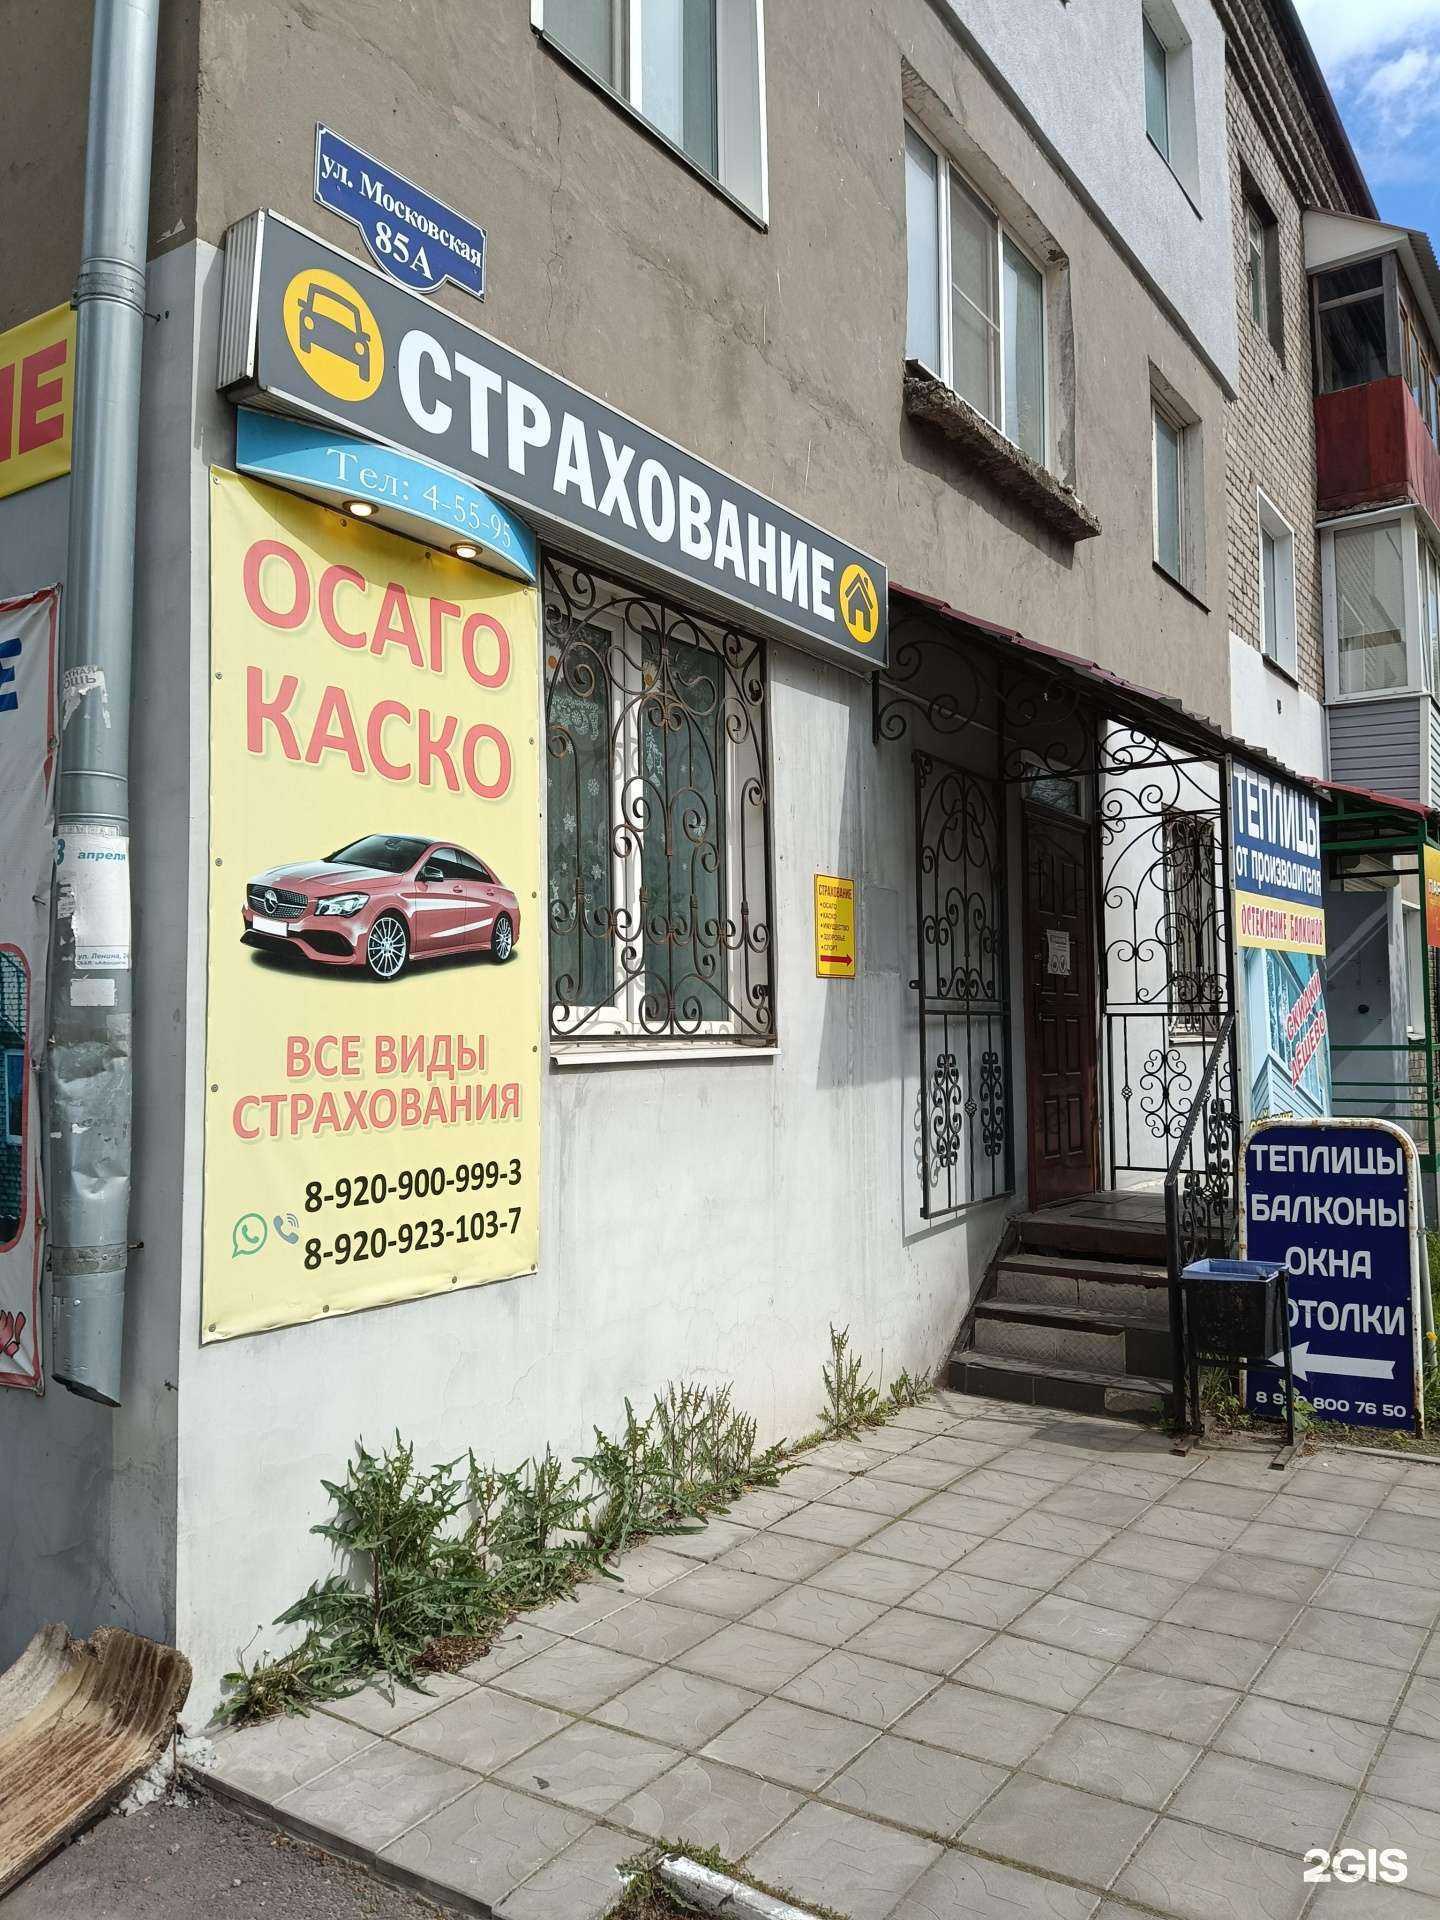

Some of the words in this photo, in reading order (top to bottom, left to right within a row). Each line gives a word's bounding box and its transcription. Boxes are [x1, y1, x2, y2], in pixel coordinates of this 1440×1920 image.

[321, 154, 353, 188] ул.
[359, 171, 482, 268] Московская
[375, 221, 434, 281] 85А
[326, 448, 409, 501] Тел:
[422, 484, 511, 548] 4-55-95
[398, 329, 836, 622] СТРАХОВАНИЕ
[243, 539, 510, 688] ОСАГО
[247, 666, 512, 798] КАСКО
[1233, 762, 1321, 859] ТЕПЛИЦЫ
[78, 850, 126, 861] апреля
[1251, 849, 1322, 896] производителя
[818, 884, 853, 899] СТРАХОВАНИЕ
[1241, 904, 1287, 940] ОСТЕКЛЕНИЕ
[1290, 914, 1323, 946] БАЛКОНОВ
[286, 1035, 361, 1077] ВСЕ
[374, 1034, 486, 1081] ВИДЫ
[1291, 1009, 1326, 1088] ДЕШЕВО
[232, 1082, 520, 1139] СТРАХОВАНИЯ
[304, 1158, 522, 1213] 8-920-900-999-3
[1250, 1144, 1404, 1176] ТЕПЛИЦЫ
[303, 1206, 522, 1270] 8-920-923-103-7
[1251, 1193, 1406, 1228] БАЛКОНЫ
[1285, 1246, 1372, 1280] ОКНА
[1287, 1297, 1405, 1336] ОТОЛКИ
[1256, 1391, 1268, 1404] 8
[1313, 1397, 1350, 1413] 800
[1354, 1401, 1377, 1416] 76
[1382, 1404, 1407, 1418] 50
